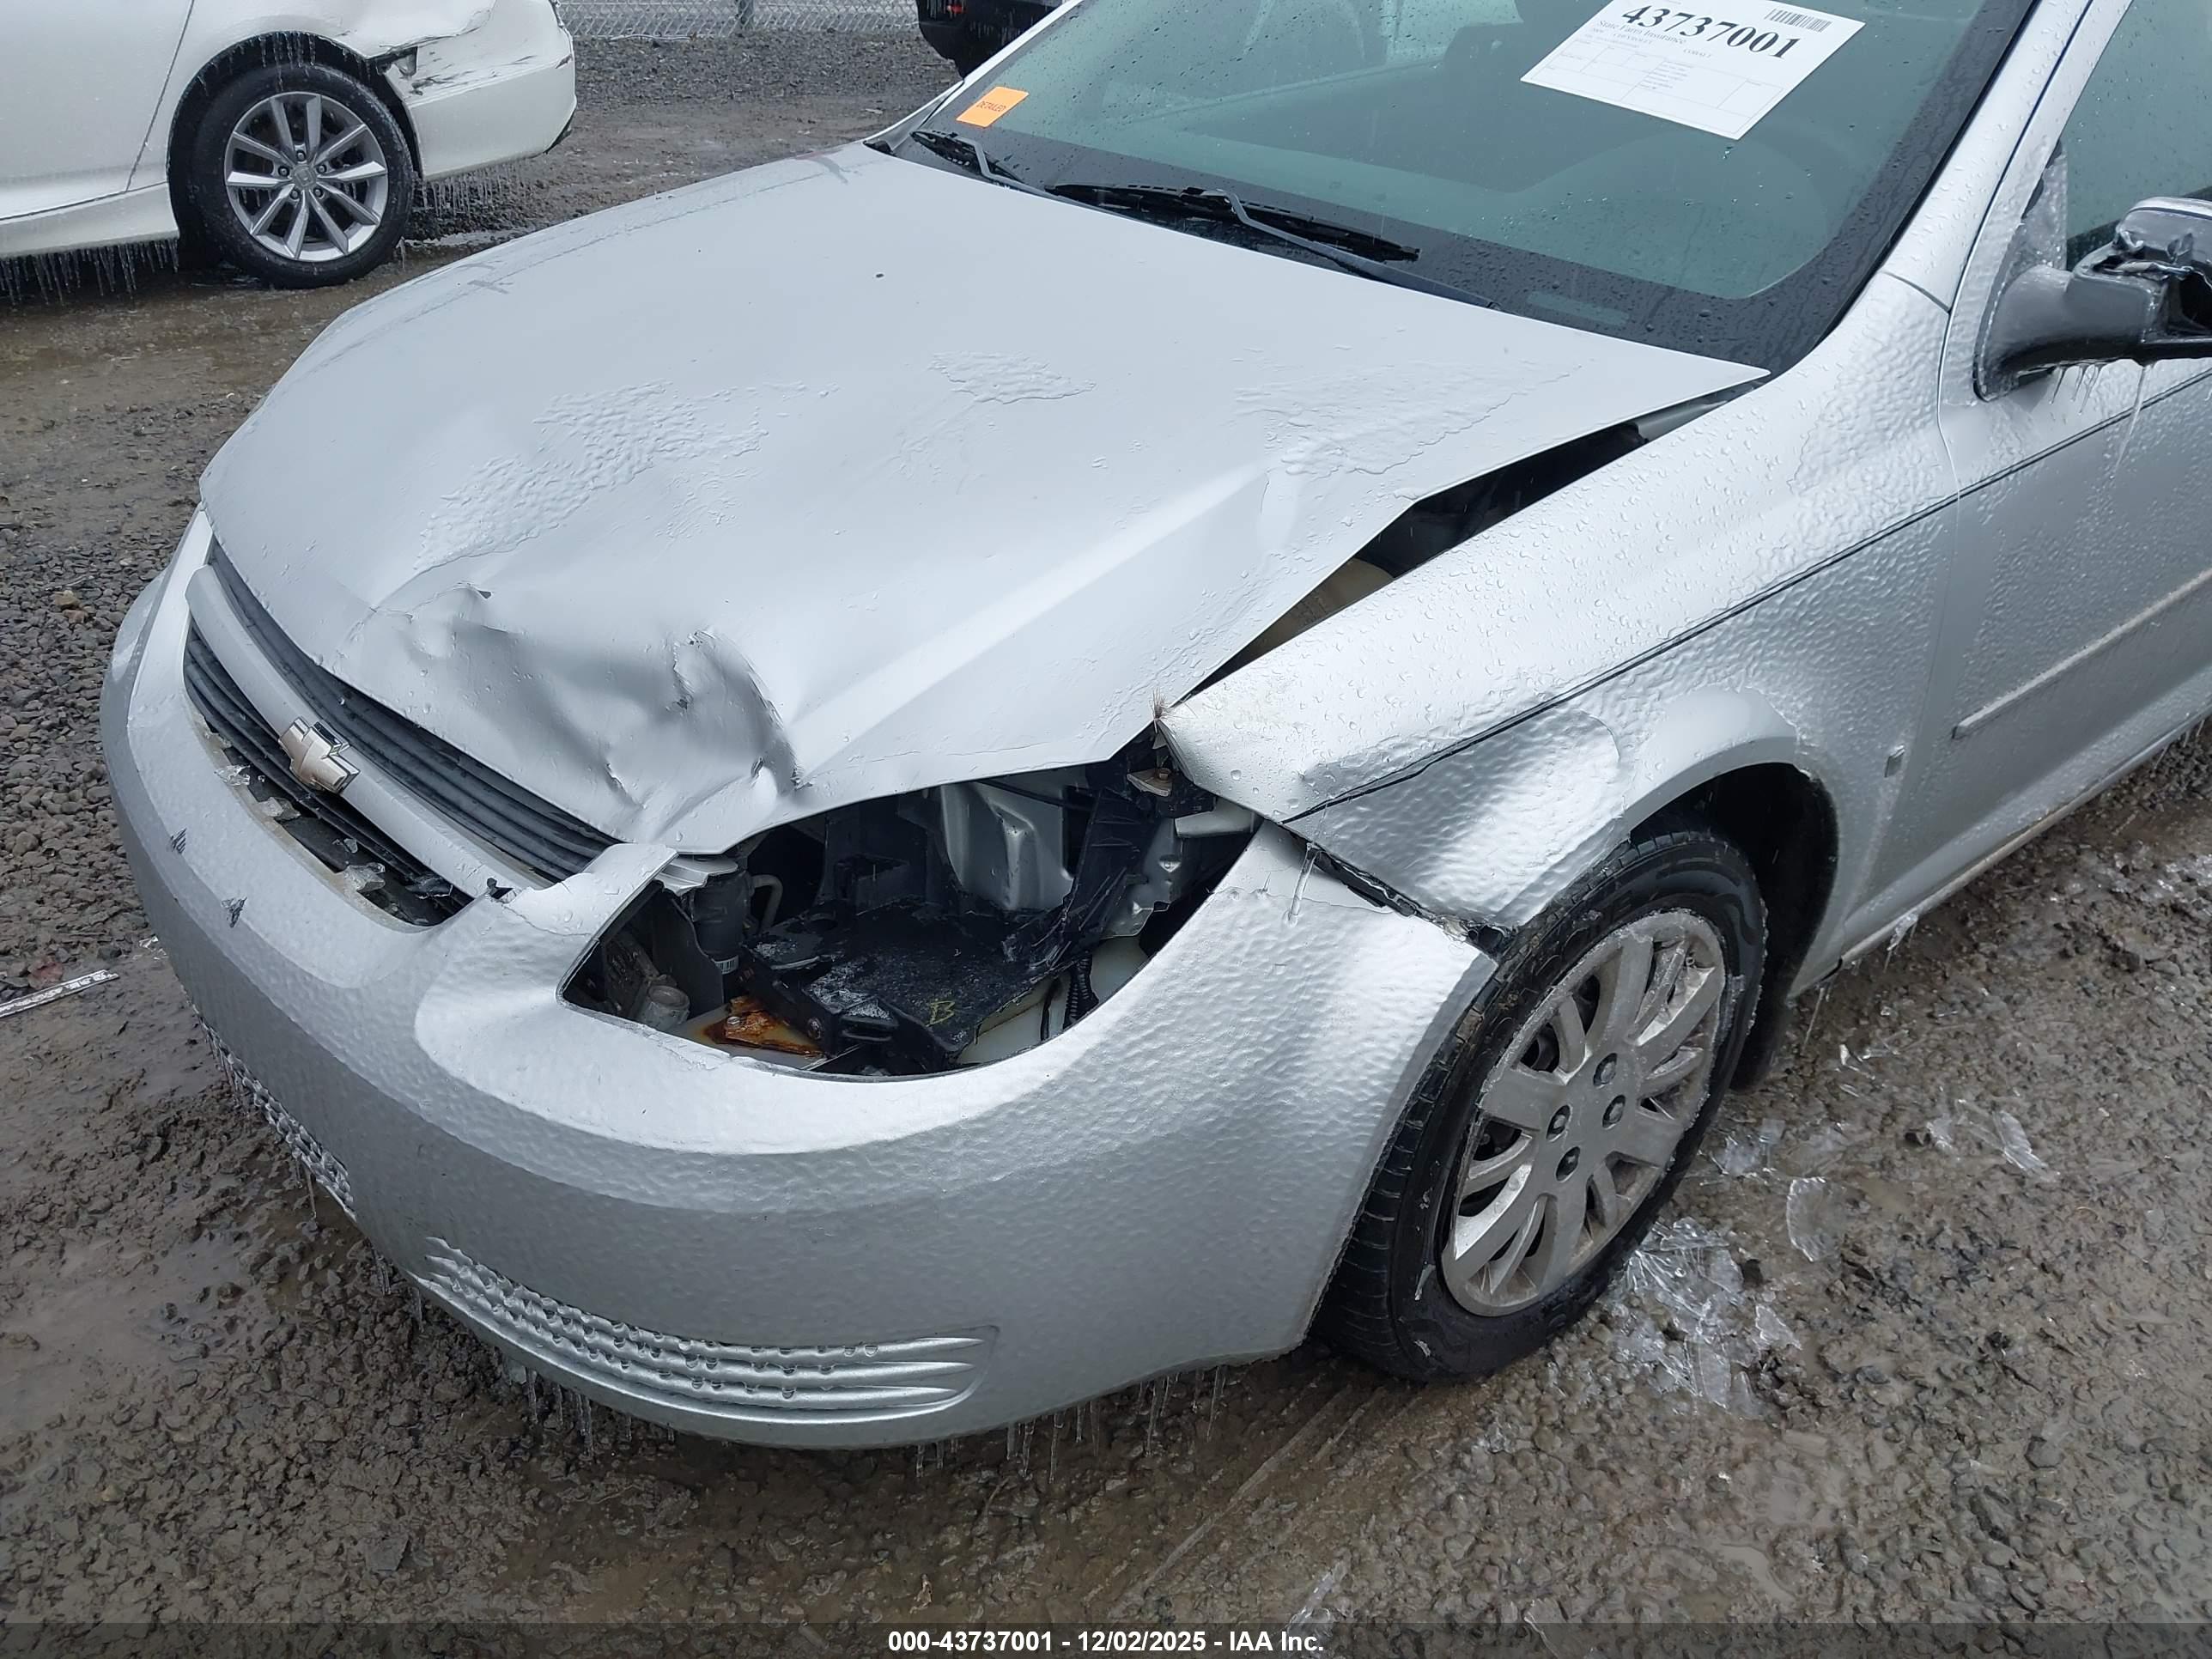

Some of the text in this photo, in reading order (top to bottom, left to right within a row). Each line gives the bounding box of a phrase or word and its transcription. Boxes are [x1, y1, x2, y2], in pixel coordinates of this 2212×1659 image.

[1599, 20, 1620, 30] State
[1620, 24, 1643, 35] Farm
[1644, 29, 1687, 45] Insurance
[1621, 5, 1802, 59] 43737001
